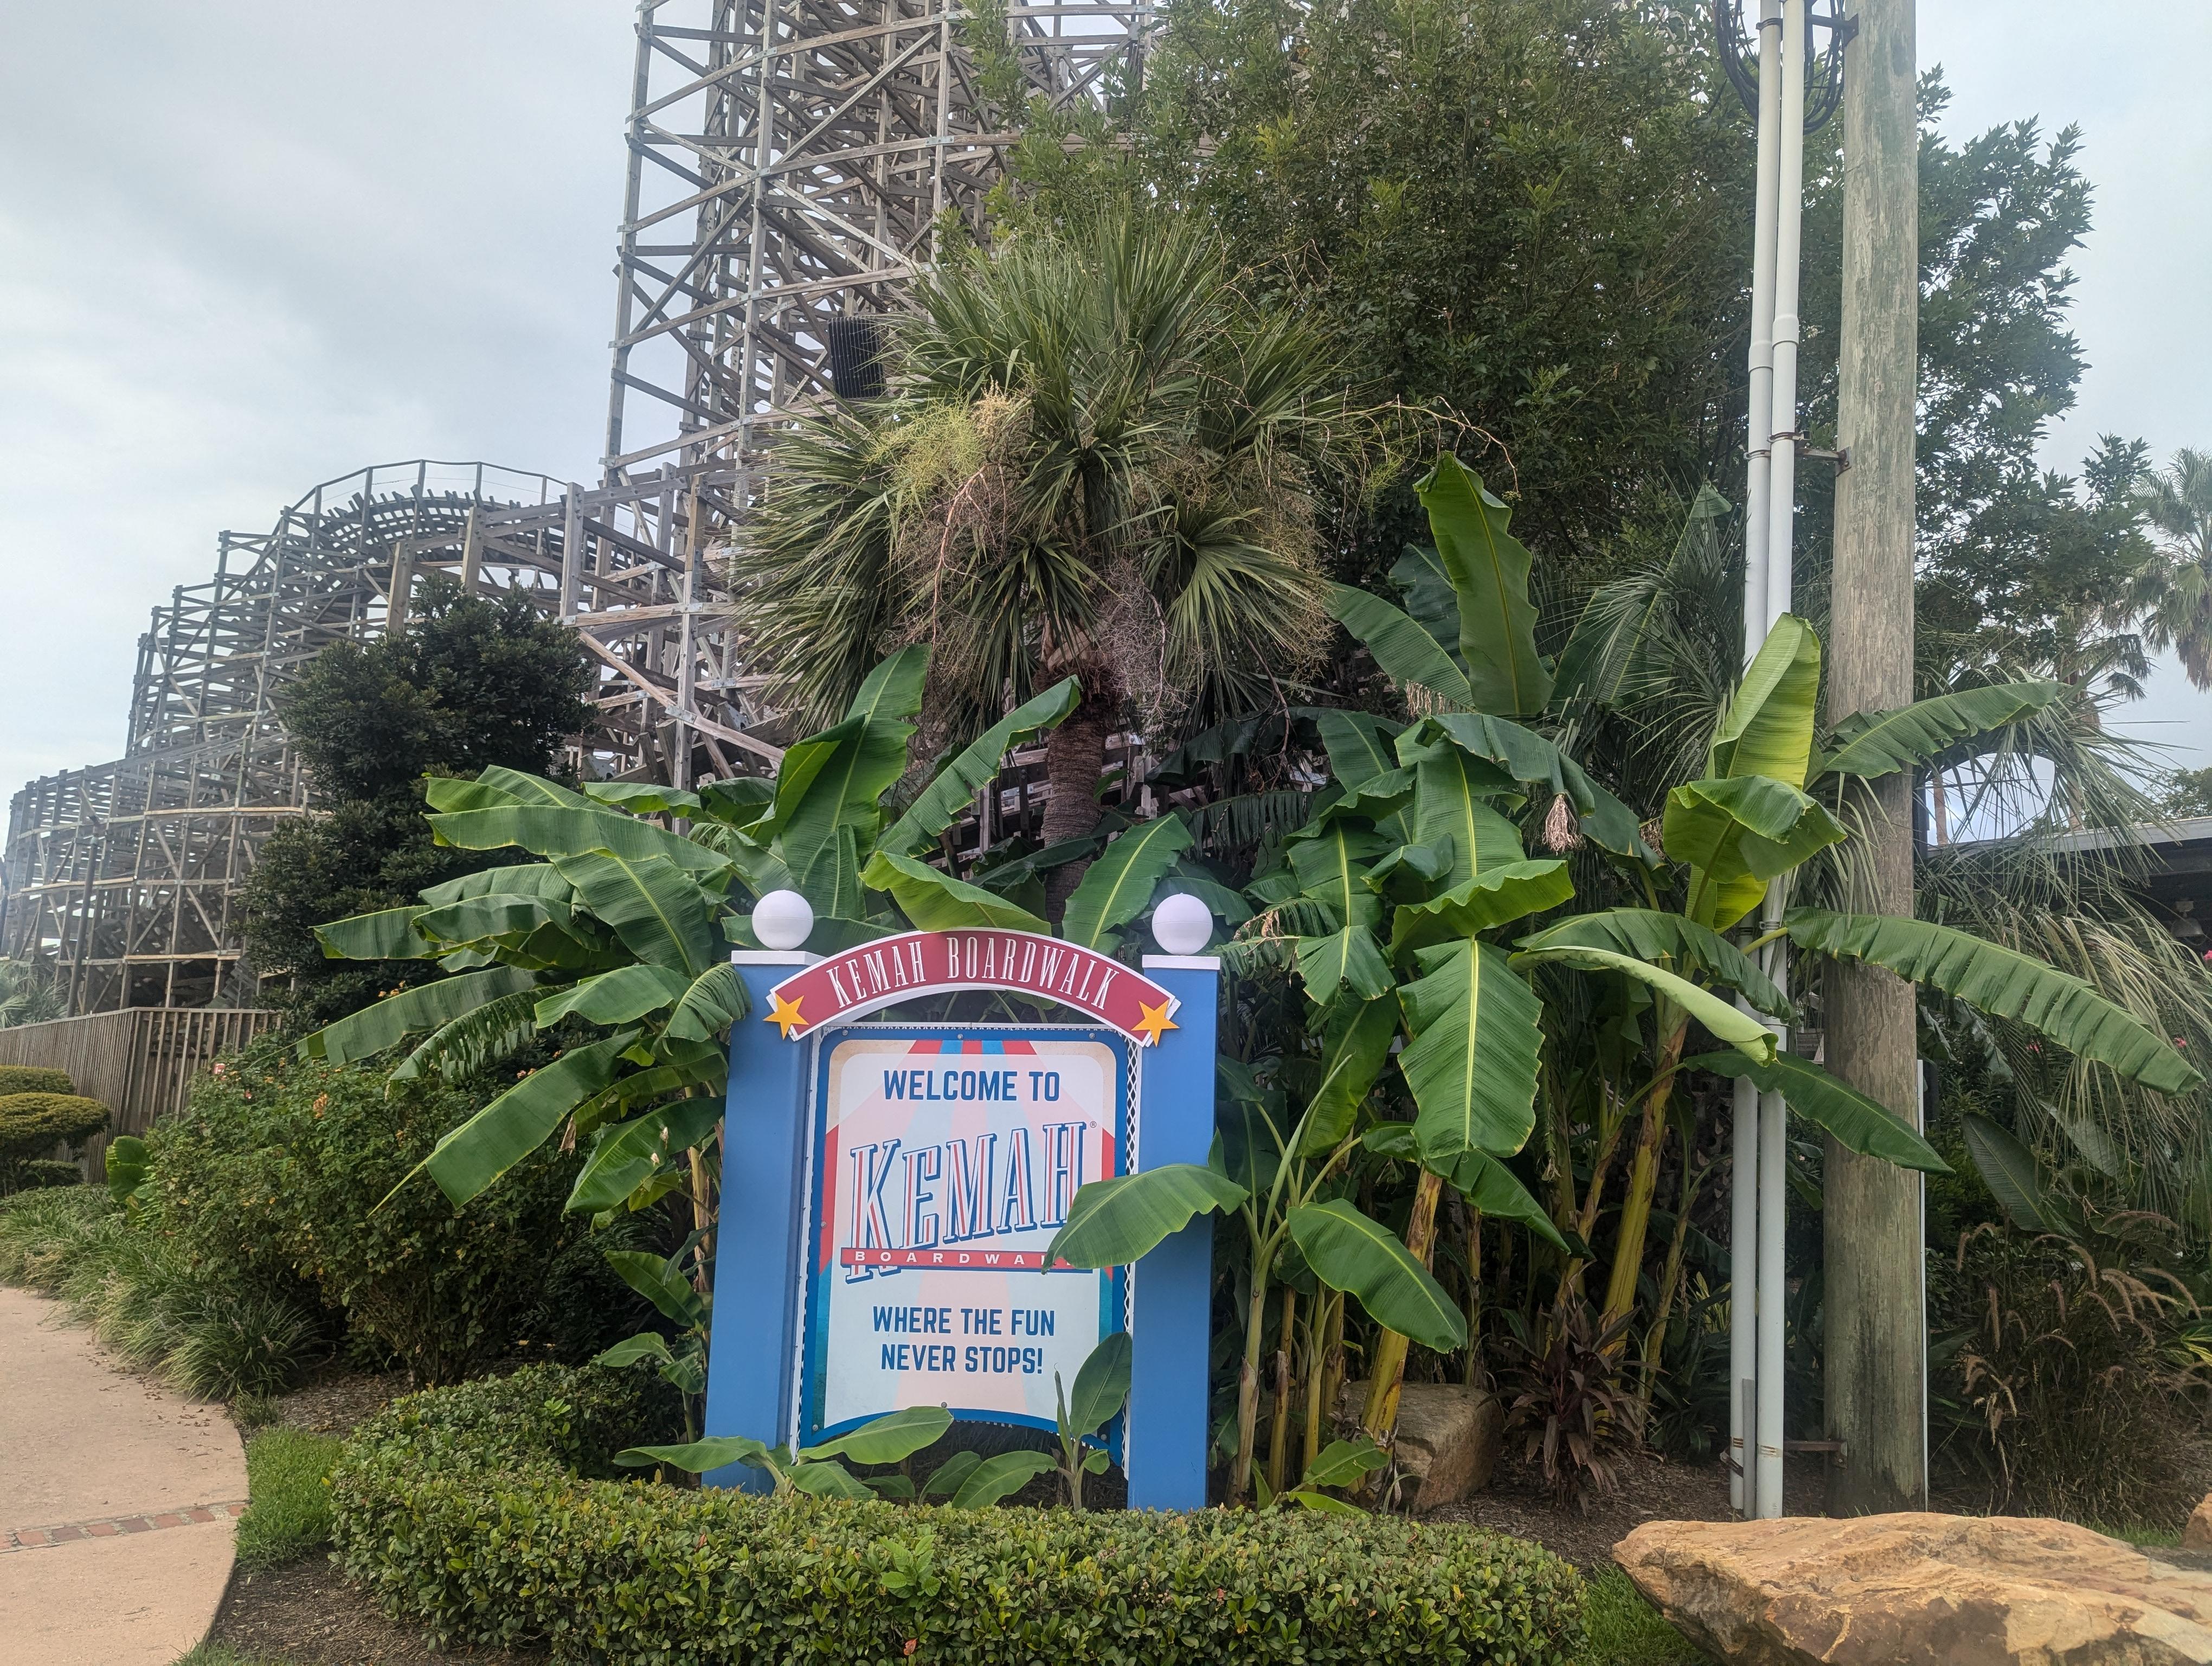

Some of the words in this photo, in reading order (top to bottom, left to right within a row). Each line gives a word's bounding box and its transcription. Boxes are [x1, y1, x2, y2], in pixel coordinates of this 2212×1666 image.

[826, 941, 927, 1009] KEMAH
[947, 937, 1120, 1010] BOARDWALK
[884, 1070, 1017, 1101] WELCOME
[1029, 1072, 1060, 1101] TO
[845, 1122, 1086, 1284] KEMAH
[855, 1251, 1072, 1266] BOARDWA
[873, 1306, 951, 1334] WHERE
[961, 1308, 1002, 1335] THE
[1011, 1310, 1054, 1336] FUN
[881, 1344, 955, 1372] NEVER
[965, 1346, 1043, 1374] STOPS!
